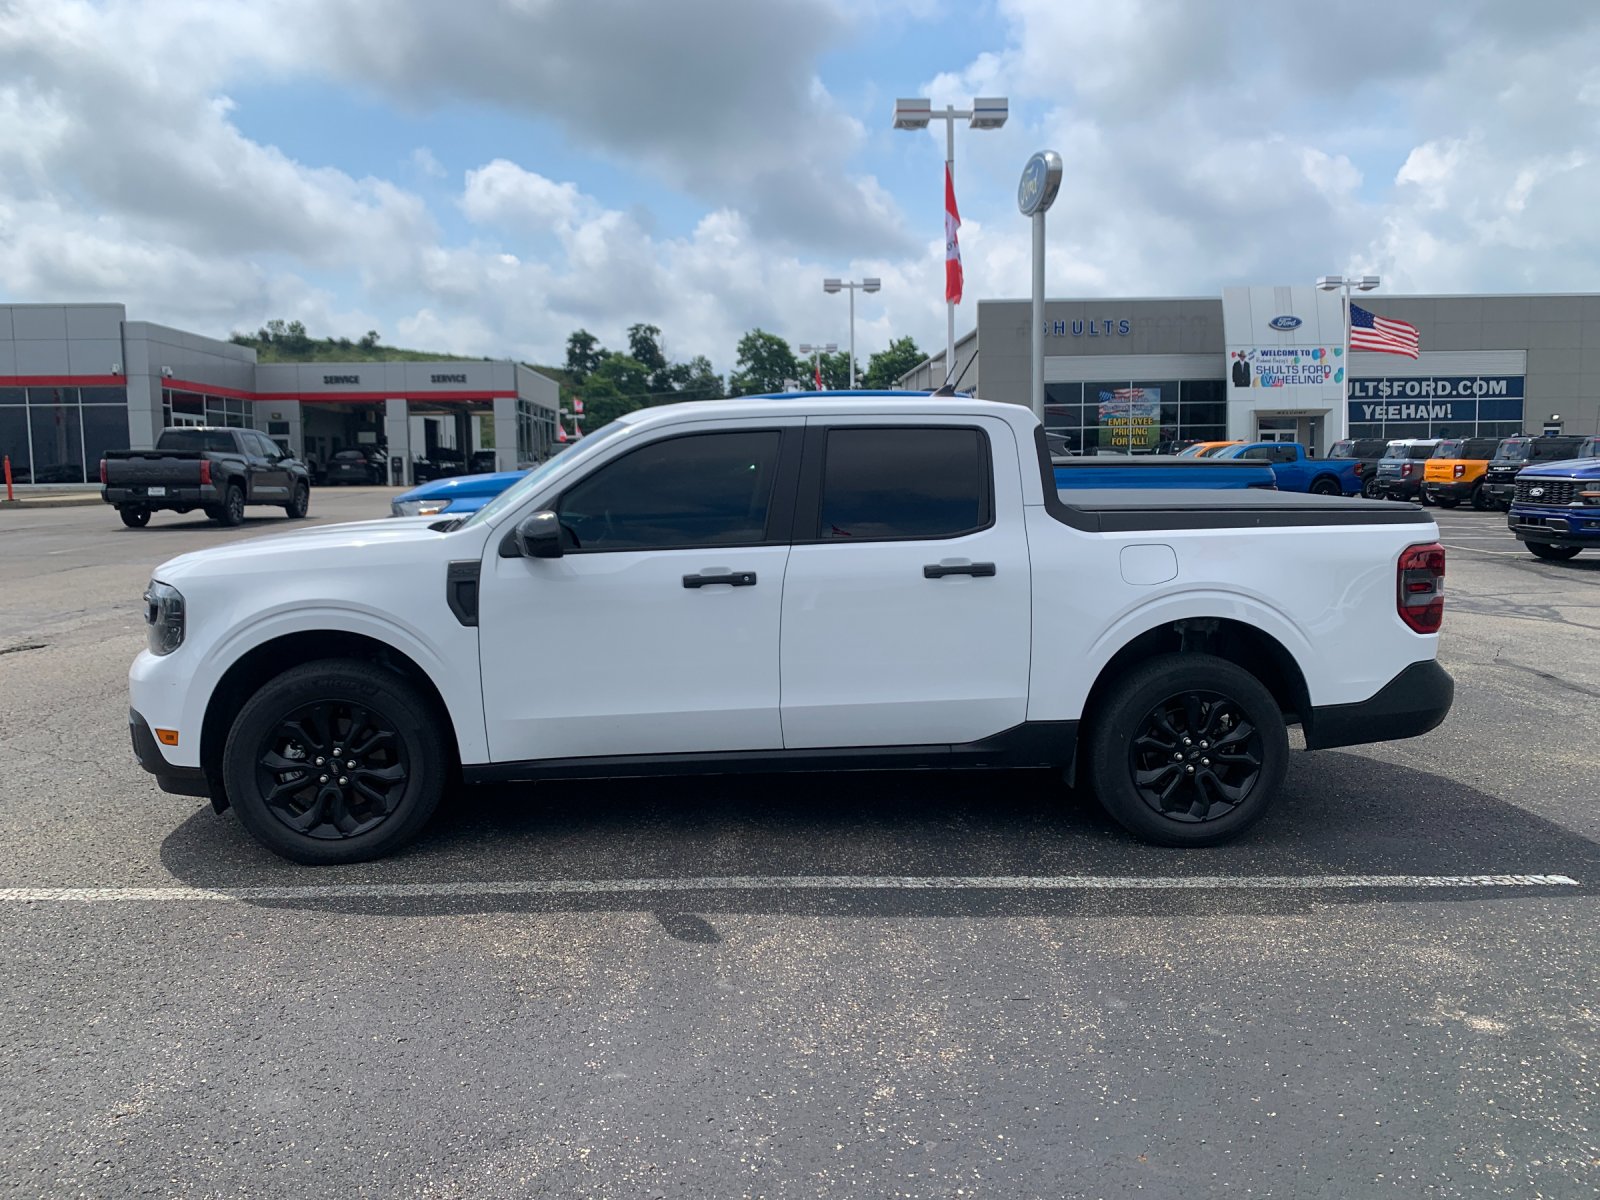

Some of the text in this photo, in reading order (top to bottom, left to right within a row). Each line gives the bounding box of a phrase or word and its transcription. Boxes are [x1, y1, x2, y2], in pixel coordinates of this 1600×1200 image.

[1260, 349, 1299, 357] WELCOME
[1300, 349, 1311, 357] TO
[1255, 364, 1332, 375] SHULTS FORD
[323, 375, 360, 384] SERVICE
[431, 374, 467, 384] SERVICE
[1264, 375, 1324, 384] WHEELING
[1107, 417, 1154, 426] EMPLOYEE
[1112, 427, 1148, 436] PRICING
[1111, 437, 1149, 446] FOR ALL!
